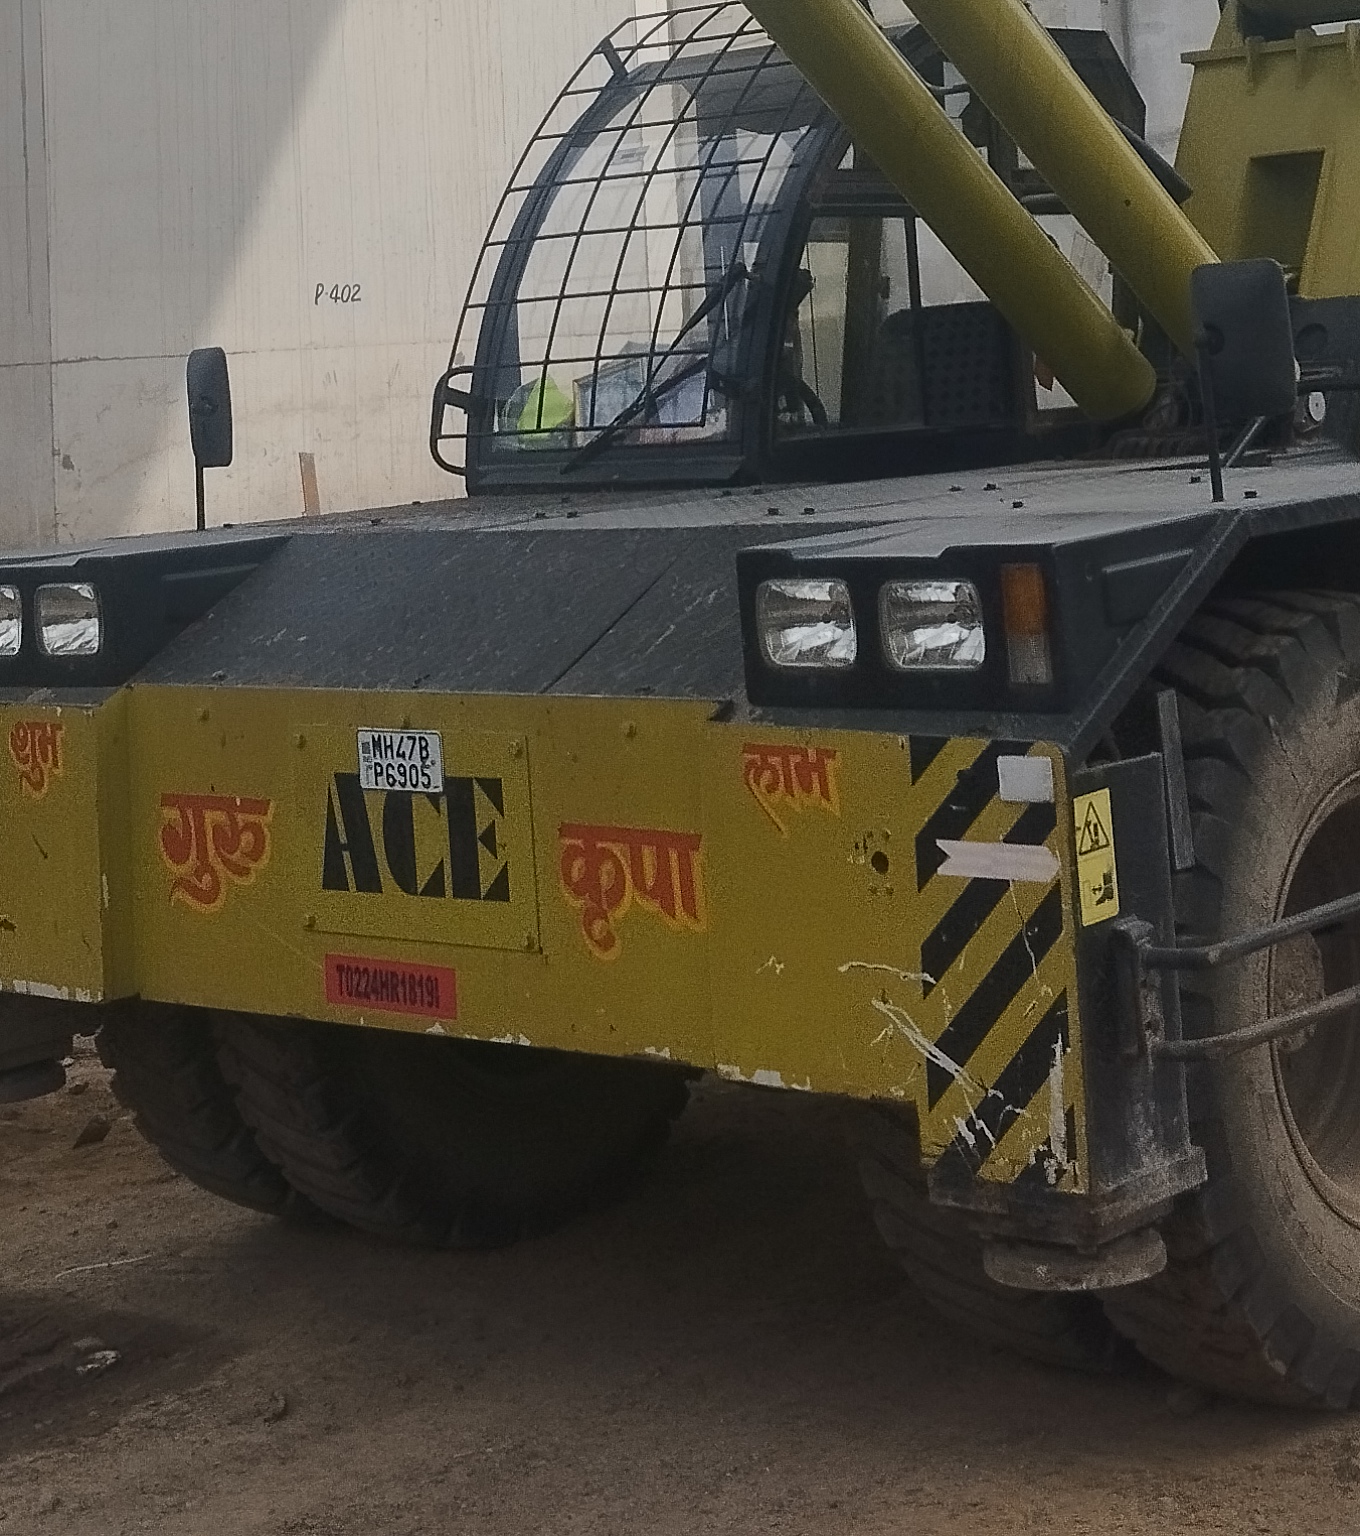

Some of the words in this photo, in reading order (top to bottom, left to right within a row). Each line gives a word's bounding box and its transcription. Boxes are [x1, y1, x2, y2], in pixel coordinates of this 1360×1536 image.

[371, 733, 430, 762] MH47B
[373, 761, 432, 789] P6905
[742, 742, 839, 836] लाभ
[322, 772, 510, 902] ACE
[558, 821, 705, 958] कृपा
